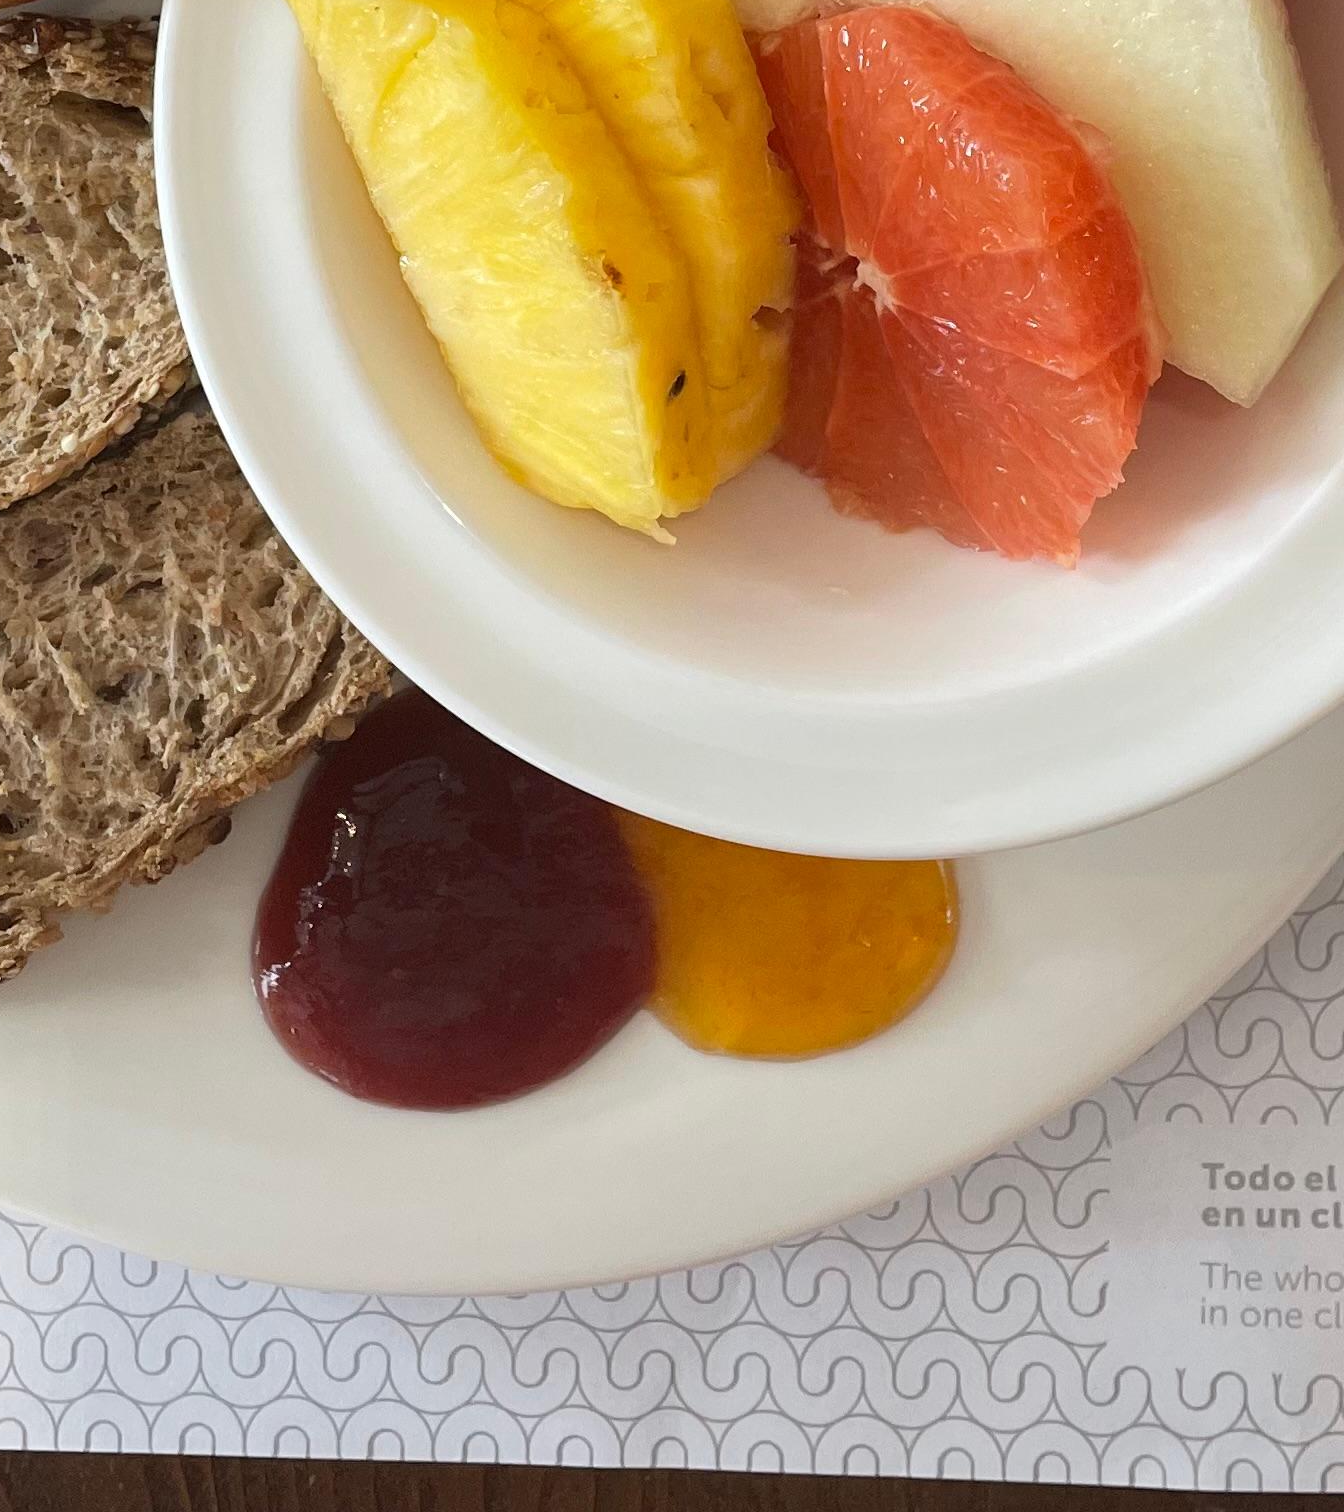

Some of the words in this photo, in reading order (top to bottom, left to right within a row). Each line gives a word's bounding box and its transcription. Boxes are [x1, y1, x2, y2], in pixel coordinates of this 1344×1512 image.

[1202, 1163, 1294, 1191] Todo
[1305, 1165, 1336, 1191] el
[1202, 1207, 1244, 1227] en
[1256, 1208, 1299, 1228] un
[1201, 1262, 1262, 1291] The
[1201, 1296, 1227, 1325] in
[1241, 1307, 1302, 1329] one
